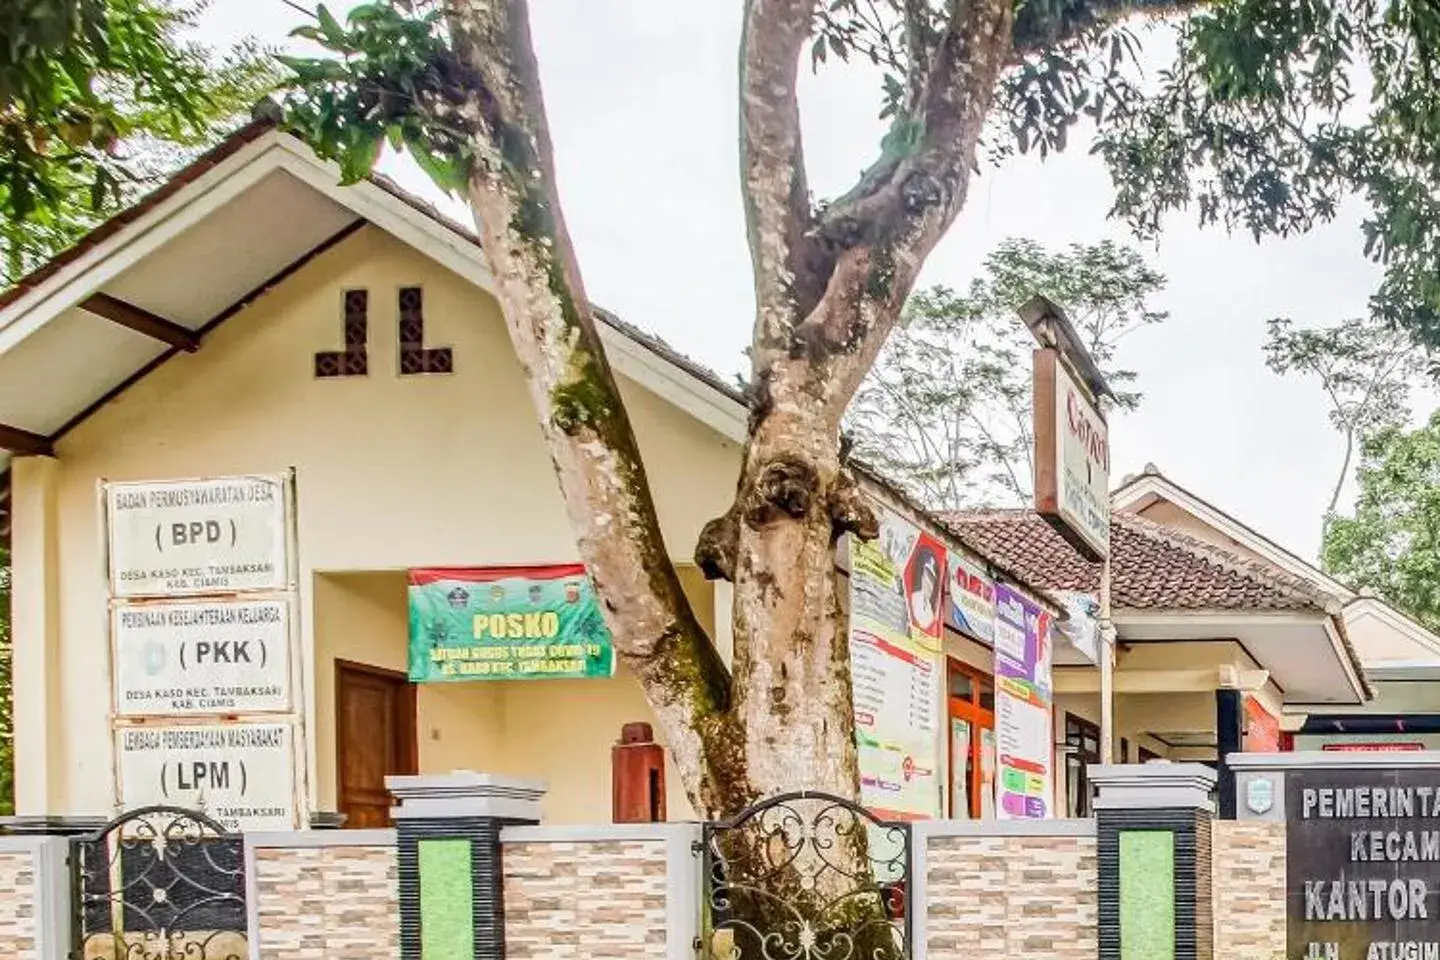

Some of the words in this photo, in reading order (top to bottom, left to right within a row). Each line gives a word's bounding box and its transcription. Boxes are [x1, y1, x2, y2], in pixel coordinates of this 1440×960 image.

[116, 490, 147, 510] BADAN
[247, 484, 274, 503] DESA
[172, 520, 221, 546] BPD
[472, 611, 560, 640] POSKO
[196, 640, 251, 664] PKK
[177, 761, 229, 790] LPM
[1304, 878, 1429, 921] KANTOR
